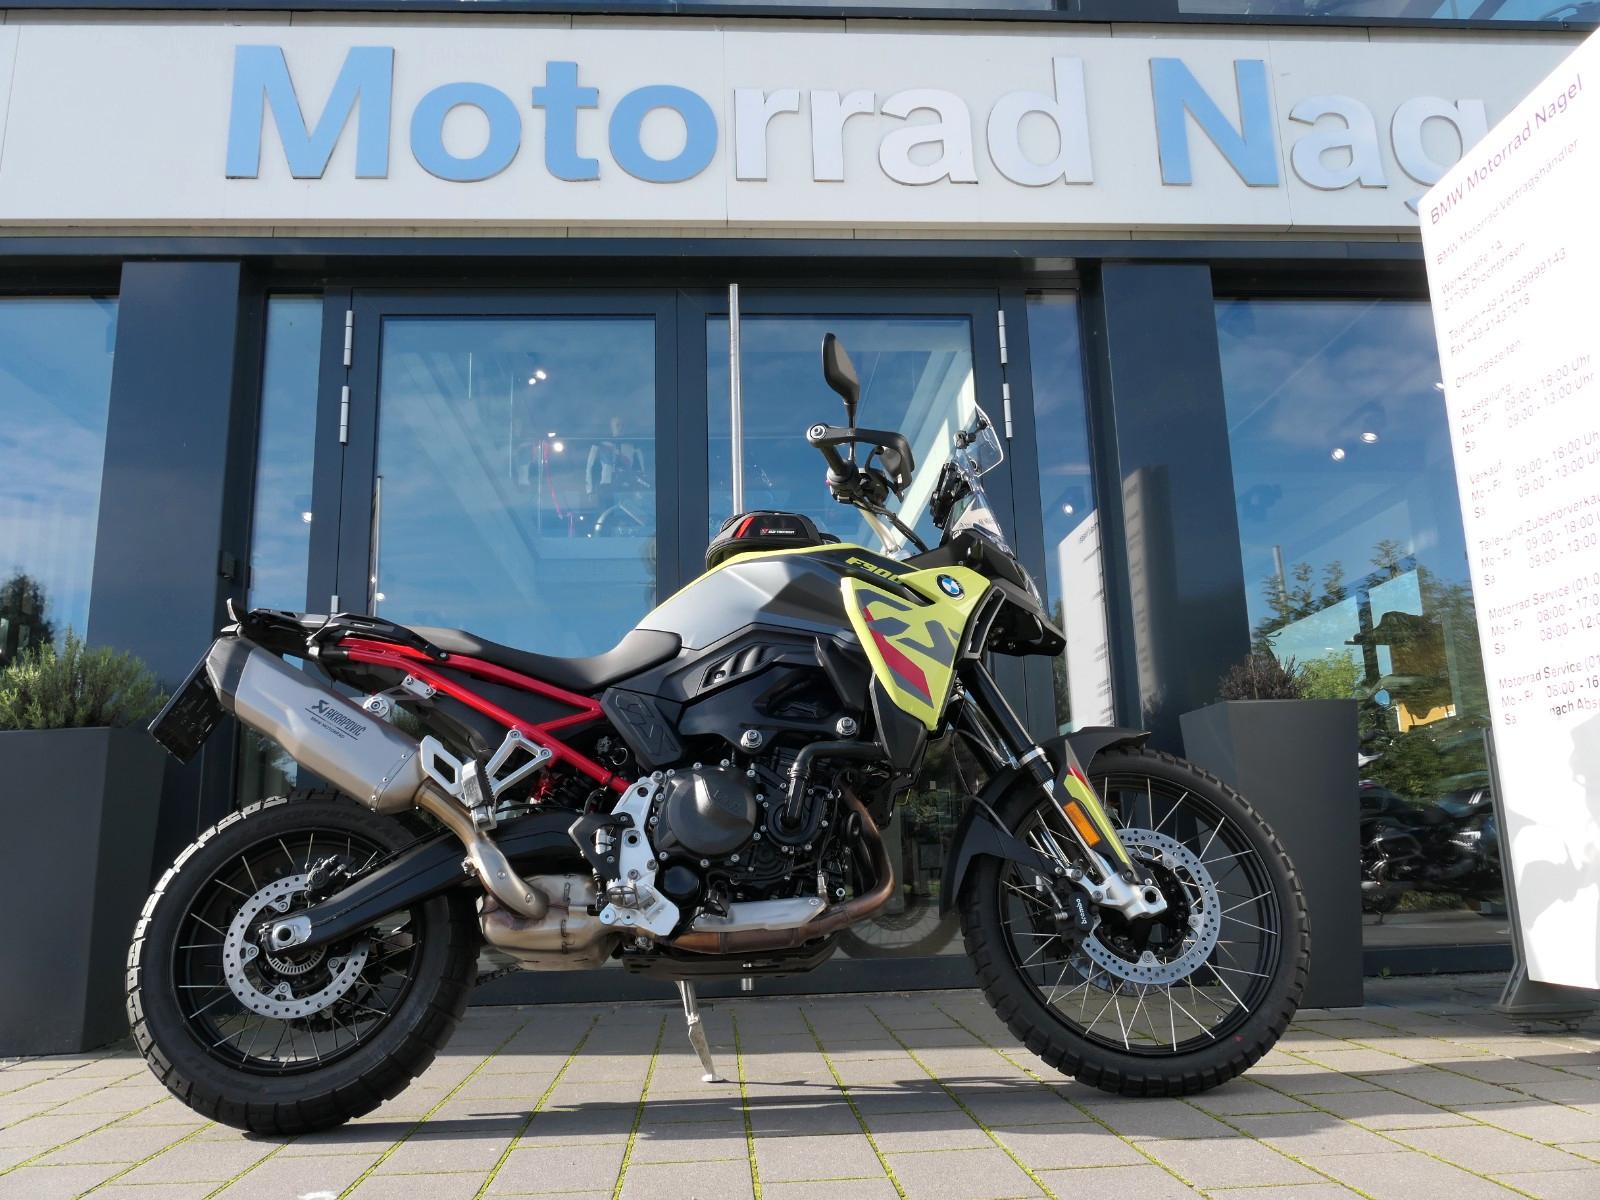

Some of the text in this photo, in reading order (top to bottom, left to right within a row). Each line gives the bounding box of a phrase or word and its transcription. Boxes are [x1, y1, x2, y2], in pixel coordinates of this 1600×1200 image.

[225, 45, 1094, 187] Motorrad
[1431, 74, 1583, 225] BMW Motorrad Nagel
[1459, 206, 1499, 242] Motorrad
[1572, 354, 1591, 372] Uhr
[1575, 372, 1595, 390] Uhr
[1564, 513, 1594, 535] 18:00
[1567, 532, 1598, 552] 13:00
[1488, 600, 1531, 621] Motorrad
[1532, 585, 1571, 607] Service
[1498, 670, 1542, 690] Motorrad
[1543, 660, 1583, 680] Service
